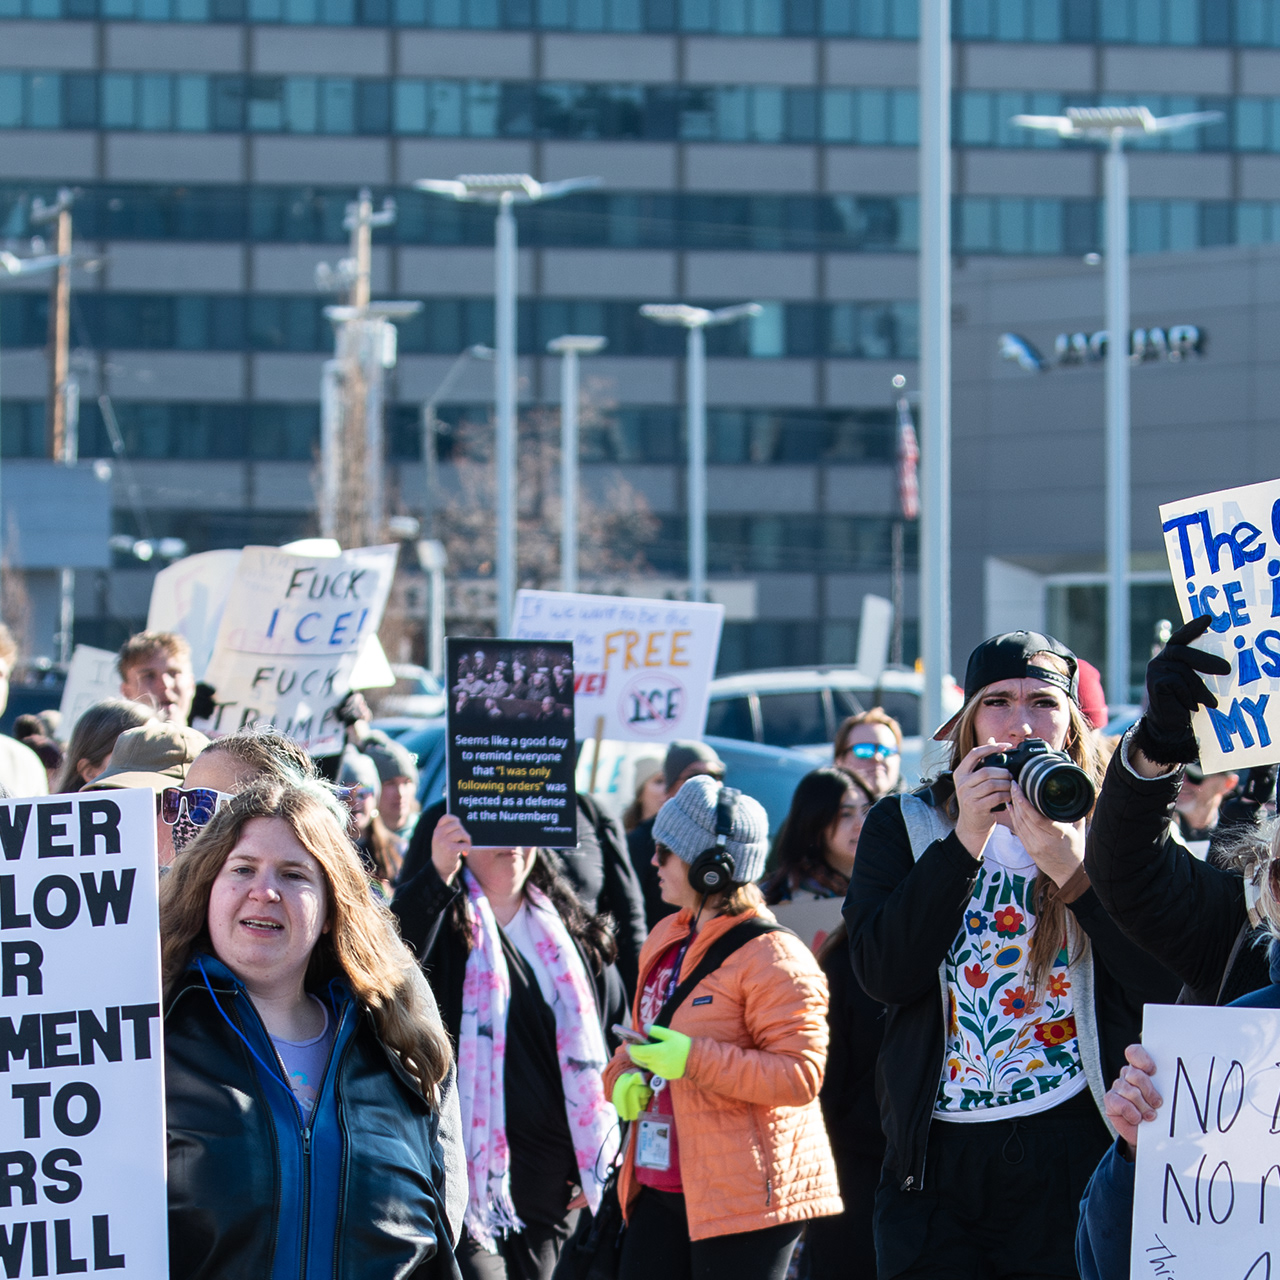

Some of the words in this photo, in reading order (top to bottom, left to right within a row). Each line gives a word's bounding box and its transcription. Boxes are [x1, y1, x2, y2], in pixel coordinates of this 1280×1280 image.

[1163, 509, 1267, 580] The
[285, 567, 368, 599] FUCK
[266, 607, 369, 645] ICE!
[603, 630, 693, 671] FREE
[251, 667, 340, 697] FUCK
[629, 686, 683, 724] ICE
[455, 734, 489, 746] Seems
[491, 735, 509, 746] like
[511, 737, 518, 746] a
[520, 736, 546, 749] good
[548, 736, 568, 749] day
[1207, 694, 1271, 754] MY
[462, 751, 473, 761] to
[475, 750, 512, 761] remind
[514, 752, 562, 764] everyone
[473, 765, 494, 776] that
[507, 767, 527, 776] was
[529, 766, 551, 778] only
[457, 779, 505, 793] following
[545, 783, 567, 792] was
[459, 795, 500, 808] rejected
[502, 797, 515, 807] as
[516, 798, 523, 807] a
[525, 796, 567, 807] defense
[467, 811, 478, 821] at
[480, 810, 498, 821] the
[499, 811, 559, 824] Nuremberg
[12, 1081, 102, 1140] TO
[1169, 1056, 1244, 1138] NO
[1162, 1154, 1236, 1226] NO
